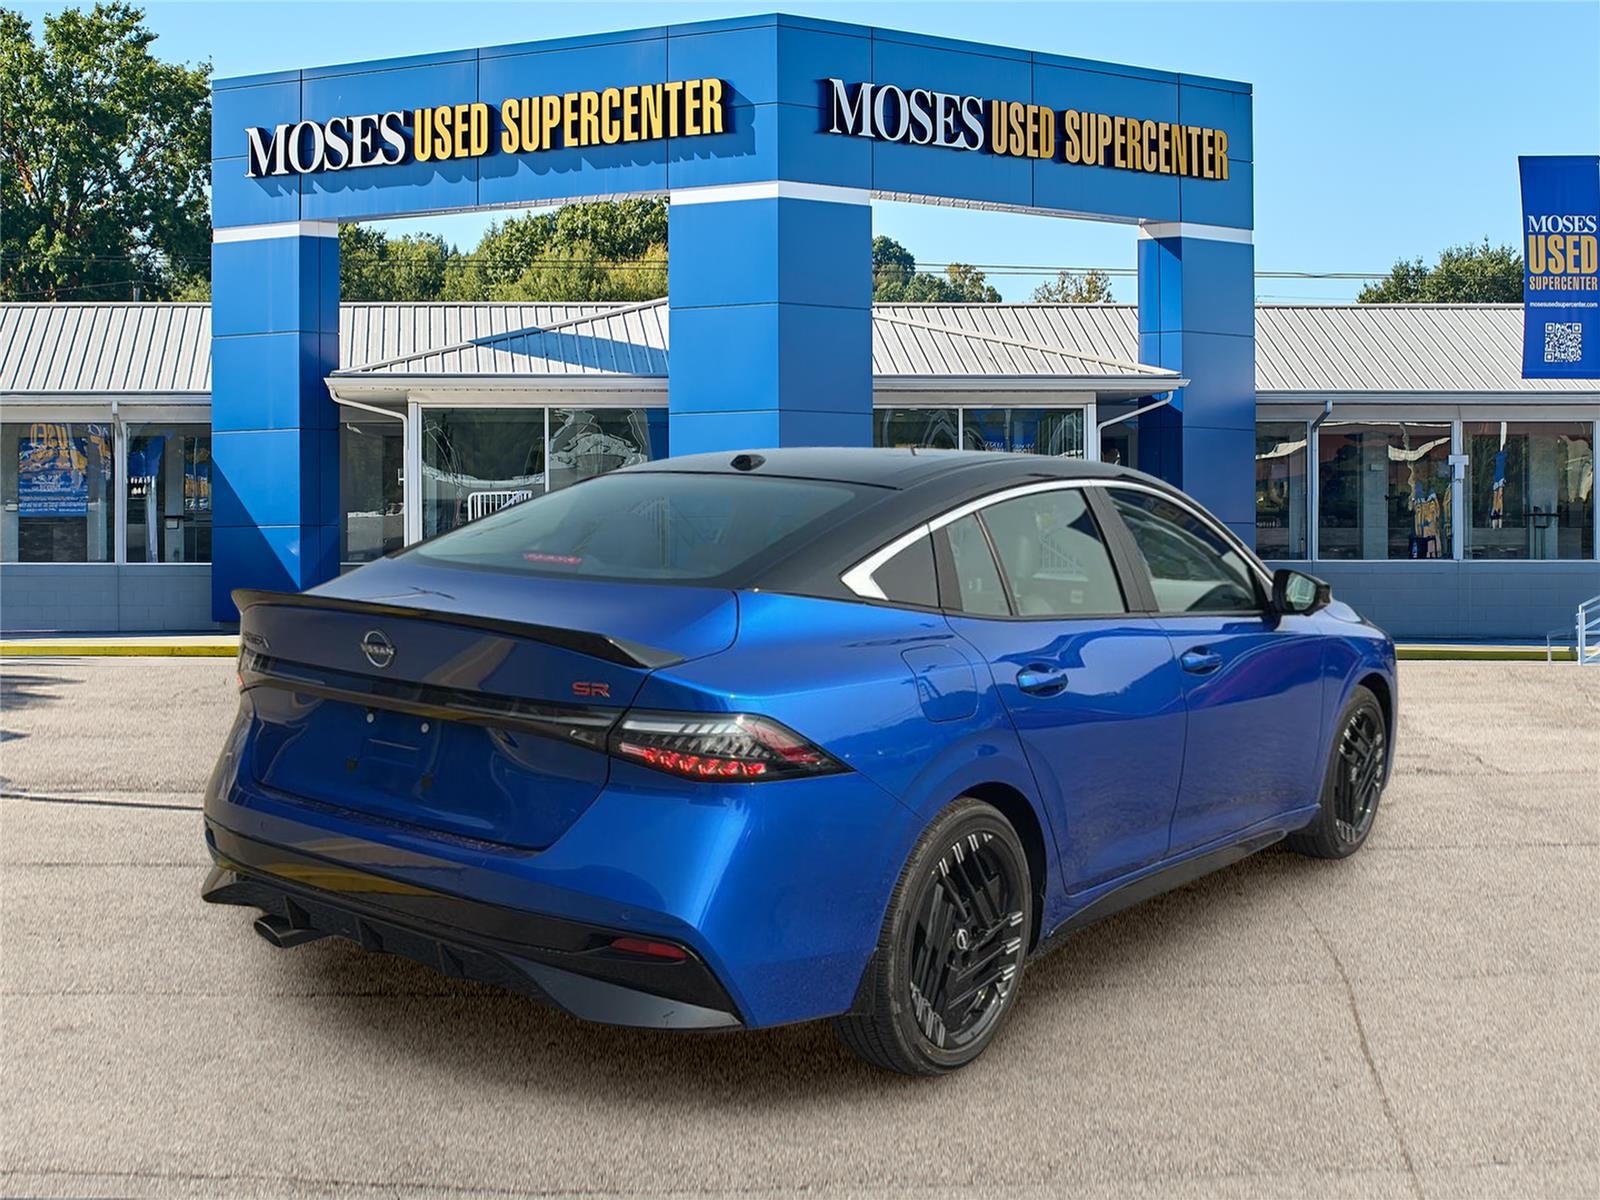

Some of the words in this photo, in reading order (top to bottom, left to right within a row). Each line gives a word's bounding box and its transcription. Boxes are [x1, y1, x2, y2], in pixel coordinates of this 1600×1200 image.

[244, 111, 406, 178] MOSES
[413, 103, 488, 162] USED
[501, 78, 723, 154] SUPERCENTER
[828, 78, 985, 151] MOSES
[991, 100, 1055, 159] USED
[1064, 109, 1229, 180] SUPERCENTER
[1528, 215, 1597, 233] MOSES
[1528, 235, 1598, 274] USED
[1529, 276, 1598, 291] SUPERCENTER
[572, 682, 610, 697] SR
